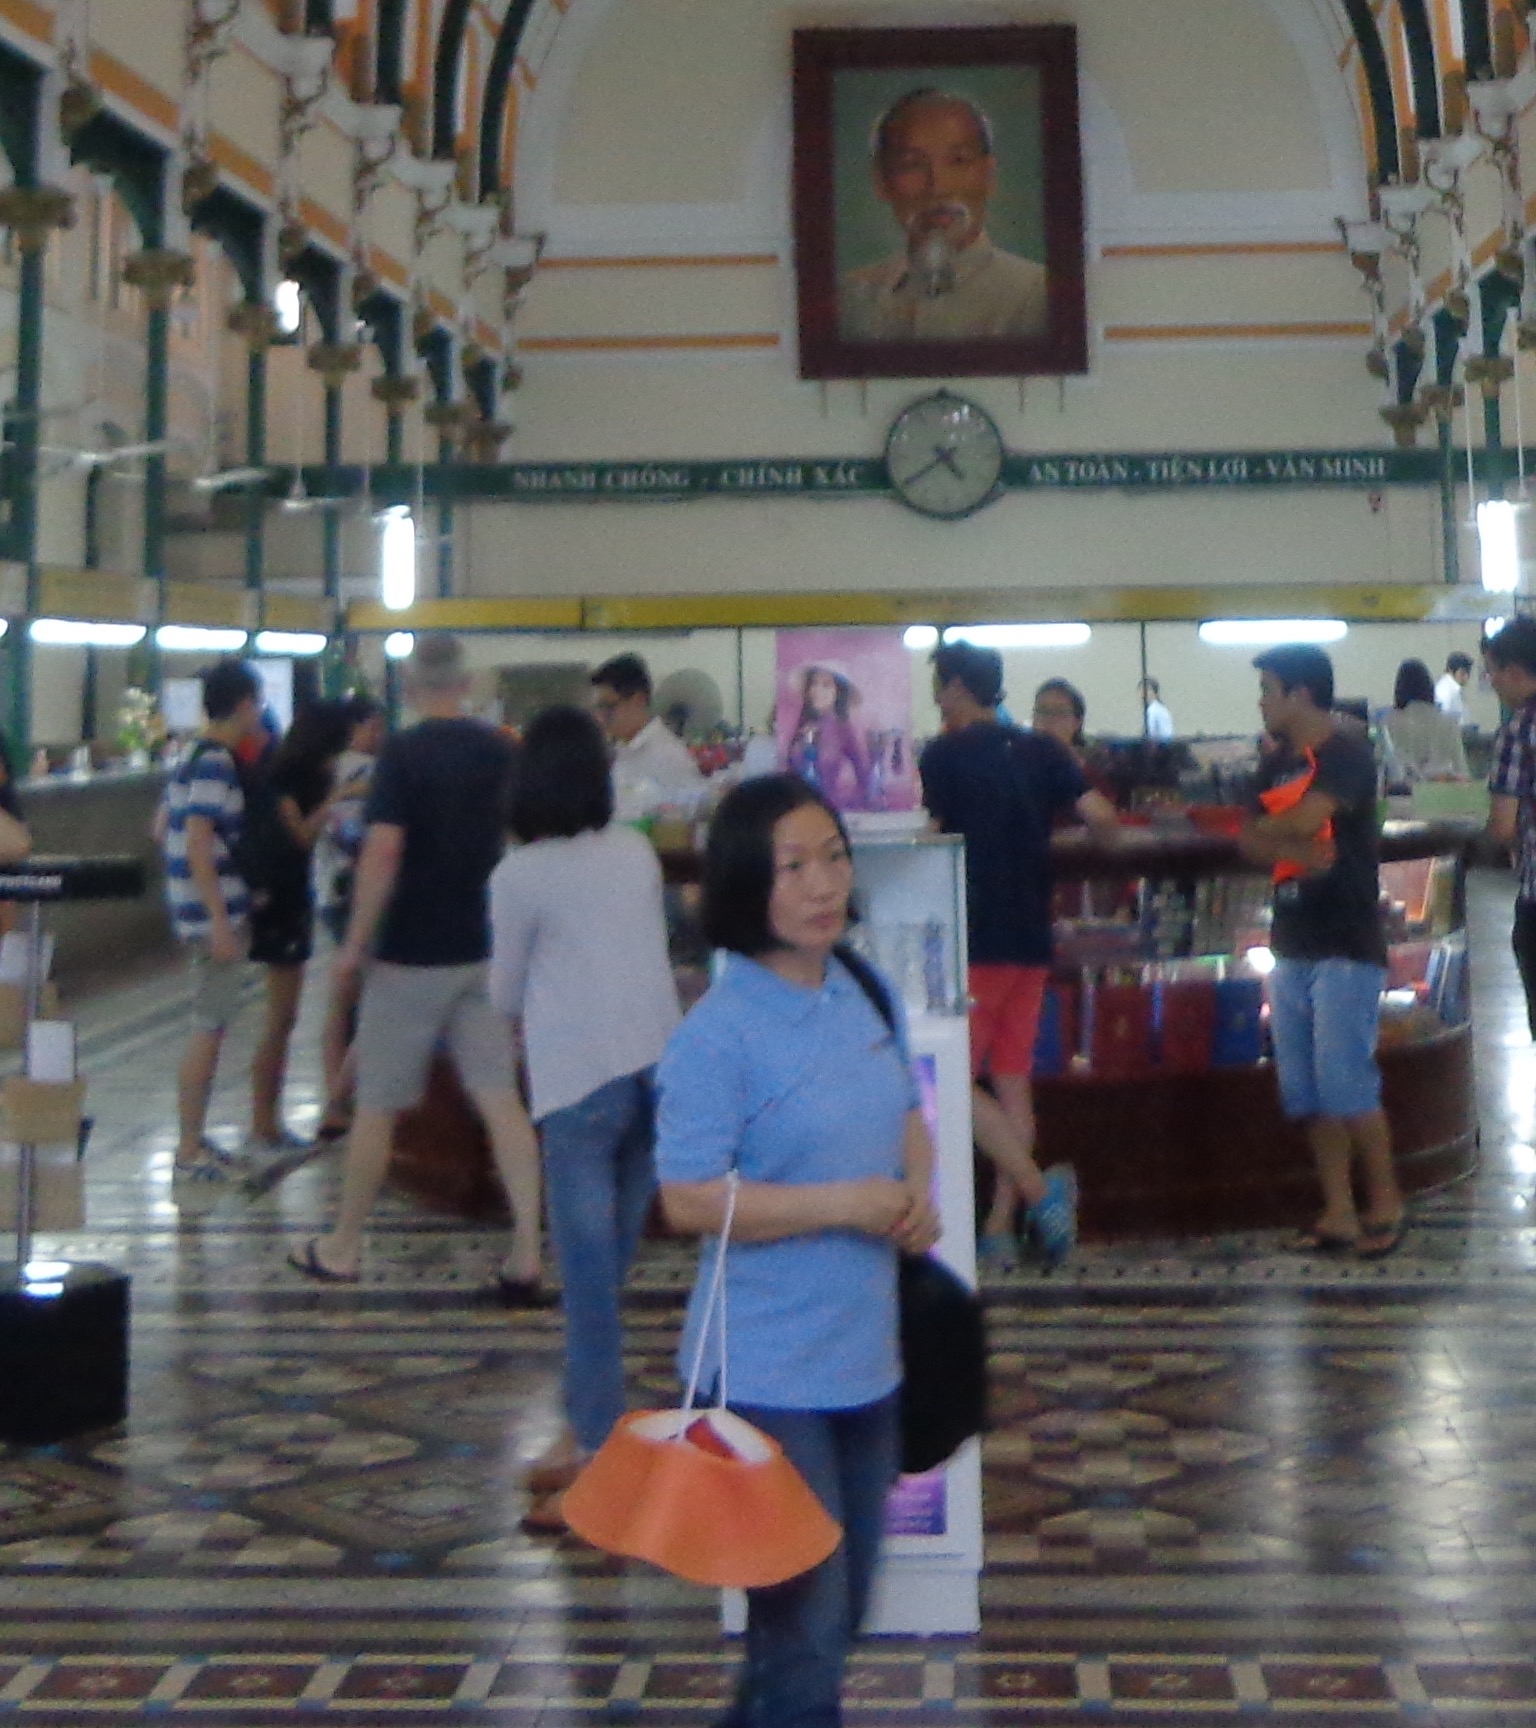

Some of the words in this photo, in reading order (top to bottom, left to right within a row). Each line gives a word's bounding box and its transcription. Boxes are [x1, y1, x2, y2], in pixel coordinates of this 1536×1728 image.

[513, 470, 597, 489] NHANH
[1028, 462, 1060, 482] AN
[1321, 456, 1386, 478] MINH
